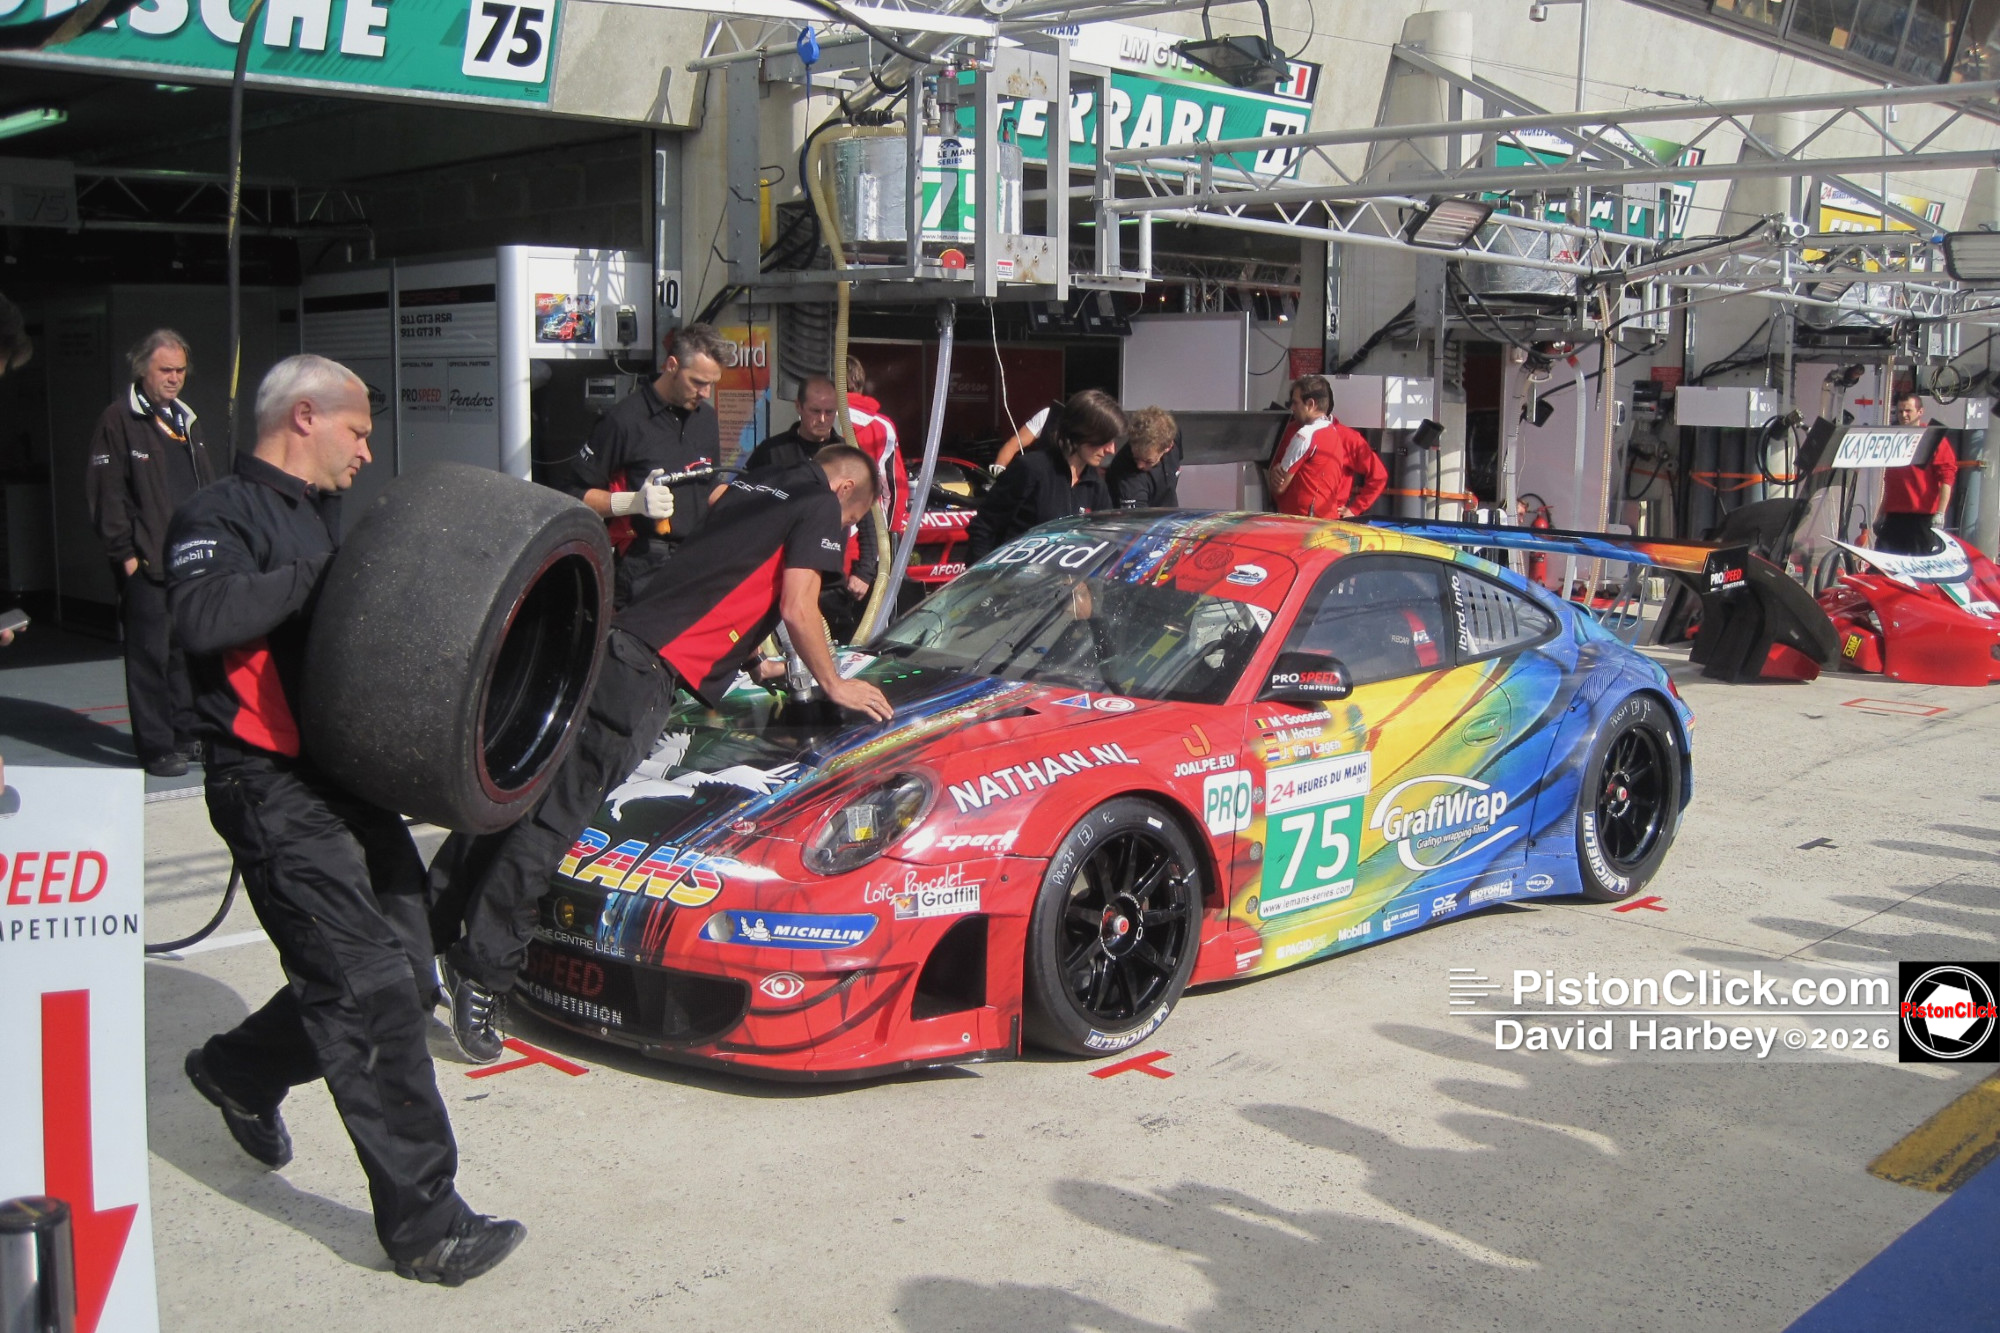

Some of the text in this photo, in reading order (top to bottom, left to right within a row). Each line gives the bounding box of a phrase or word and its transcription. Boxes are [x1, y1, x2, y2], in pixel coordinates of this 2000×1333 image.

[474, 2, 544, 67] 75
[1120, 34, 1149, 63] LM
[937, 150, 948, 158] LE
[1263, 122, 1297, 166] 71
[937, 157, 962, 166] SERIES
[658, 280, 678, 309] 10
[401, 313, 453, 325] 911 GT3 RSR
[401, 327, 441, 337] 911 GT3 R
[450, 389, 494, 407] Penders
[1839, 431, 1914, 464] KASPERSKY
[174, 549, 214, 567] Mobil 1
[1845, 635, 1858, 657] OMP
[1272, 672, 1340, 684] PROSPEED
[1299, 684, 1346, 693] COMPETITION
[1269, 710, 1331, 728] M. Goossens
[1276, 725, 1322, 743] M. Holzer
[1292, 744, 1311, 757] Van
[1314, 739, 1341, 755] Lagen
[1174, 754, 1235, 777] JOALPE.EU
[948, 742, 1140, 813] NATHAN.NL
[1270, 761, 1367, 804] 24 HEURES DU MANS
[1207, 782, 1251, 824] PRO
[1382, 791, 1508, 842] GrafiWrap
[1280, 804, 1351, 889] 75
[1416, 823, 1489, 850] Grafityp wrapping films
[1584, 815, 1618, 890] MICHELIN
[0, 850, 108, 905] EED
[904, 864, 966, 896] Poncelet
[922, 886, 978, 906] Graffiti
[1262, 884, 1351, 914] www.lemans-series.com
[1432, 893, 1457, 908] OZ
[1470, 885, 1500, 899] MOTON
[555, 931, 593, 949] CENTRE
[774, 924, 864, 940] MICHELIN
[1338, 924, 1362, 942] Mobil
[529, 981, 622, 1025] COMPETITION
[1088, 1022, 1154, 1048] MICHELIN
